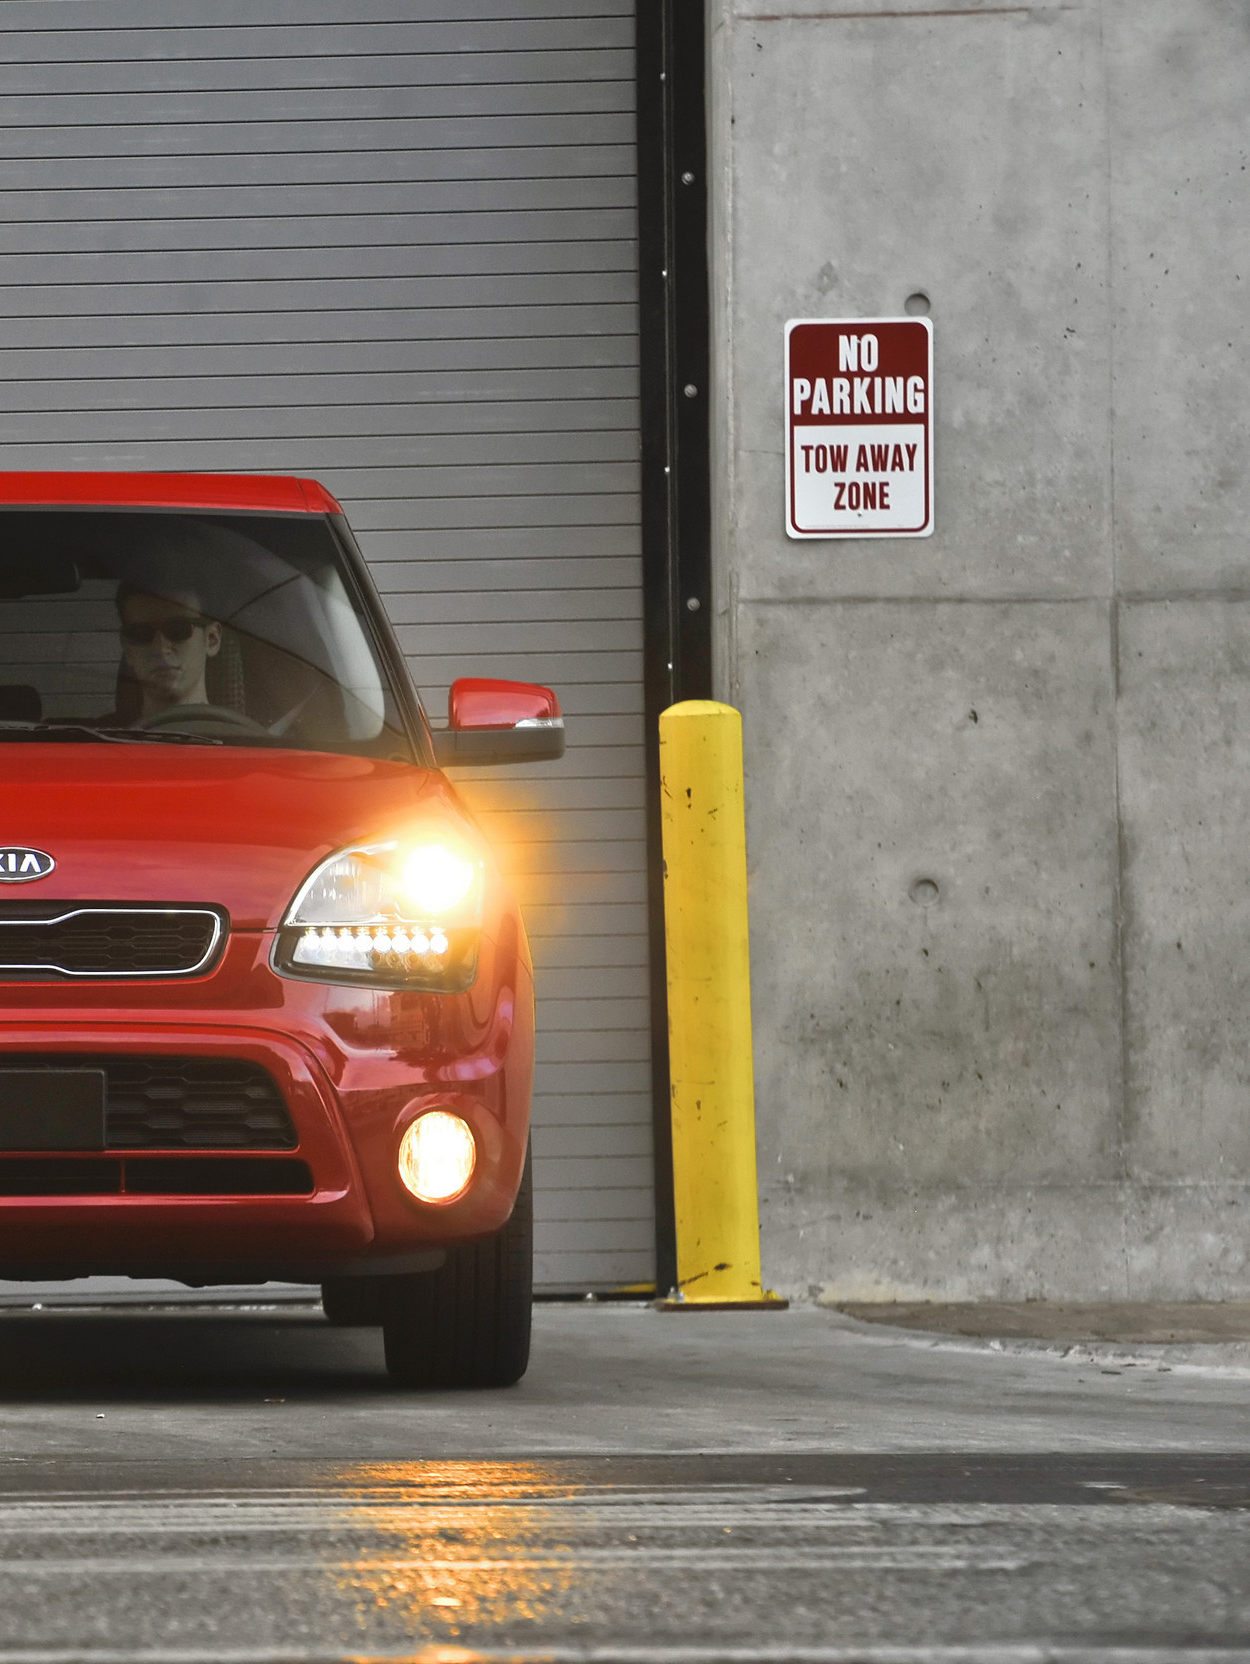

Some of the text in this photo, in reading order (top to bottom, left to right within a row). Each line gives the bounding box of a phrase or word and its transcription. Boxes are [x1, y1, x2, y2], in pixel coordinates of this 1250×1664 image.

[839, 334, 879, 372] NO
[793, 376, 925, 415] PARKING
[801, 444, 917, 473] TOW AWAY
[834, 482, 890, 511] ZONE
